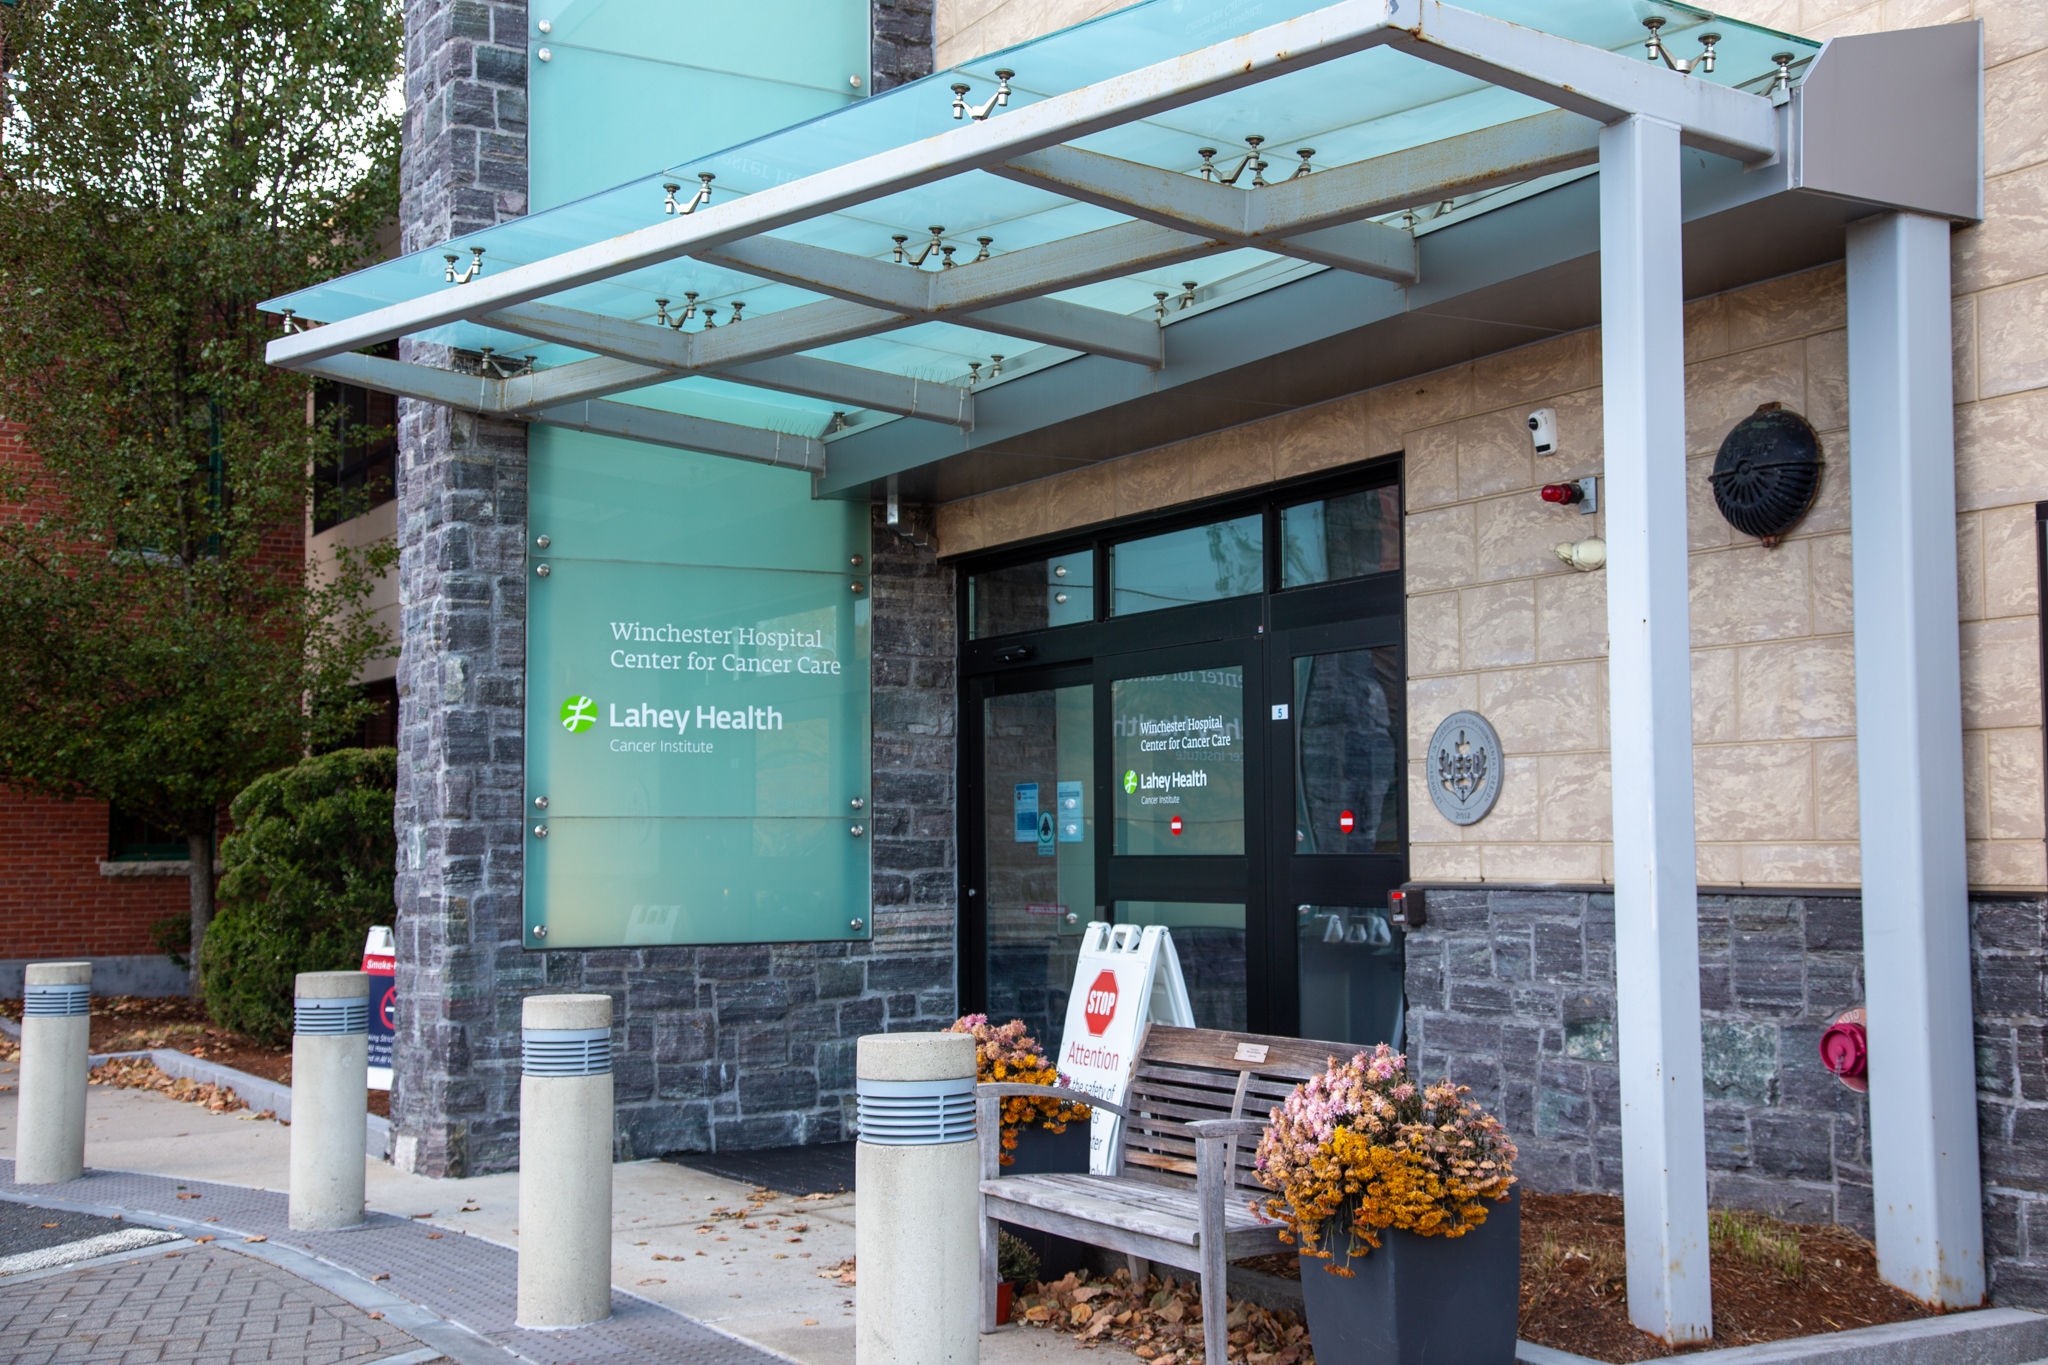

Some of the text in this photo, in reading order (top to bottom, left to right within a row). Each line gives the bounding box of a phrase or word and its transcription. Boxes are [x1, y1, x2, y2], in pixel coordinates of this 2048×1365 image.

[609, 621, 823, 651] Winchester Hospital
[610, 650, 841, 675] Center for Cancer Care
[609, 702, 783, 735] Lahey Health
[1278, 708, 1283, 719] 5
[1140, 715, 1223, 735] Winchester Hospital
[610, 739, 714, 753] Cancer Institute
[1141, 734, 1231, 752] Center for Cancer Care
[1141, 769, 1207, 792] Lahey Health
[1141, 795, 1180, 805] Cancer Institute
[1087, 990, 1116, 1016] STOP
[1067, 1041, 1119, 1072] Attention
[1085, 1081, 1106, 1099] safety
[1106, 1084, 1117, 1101] of
